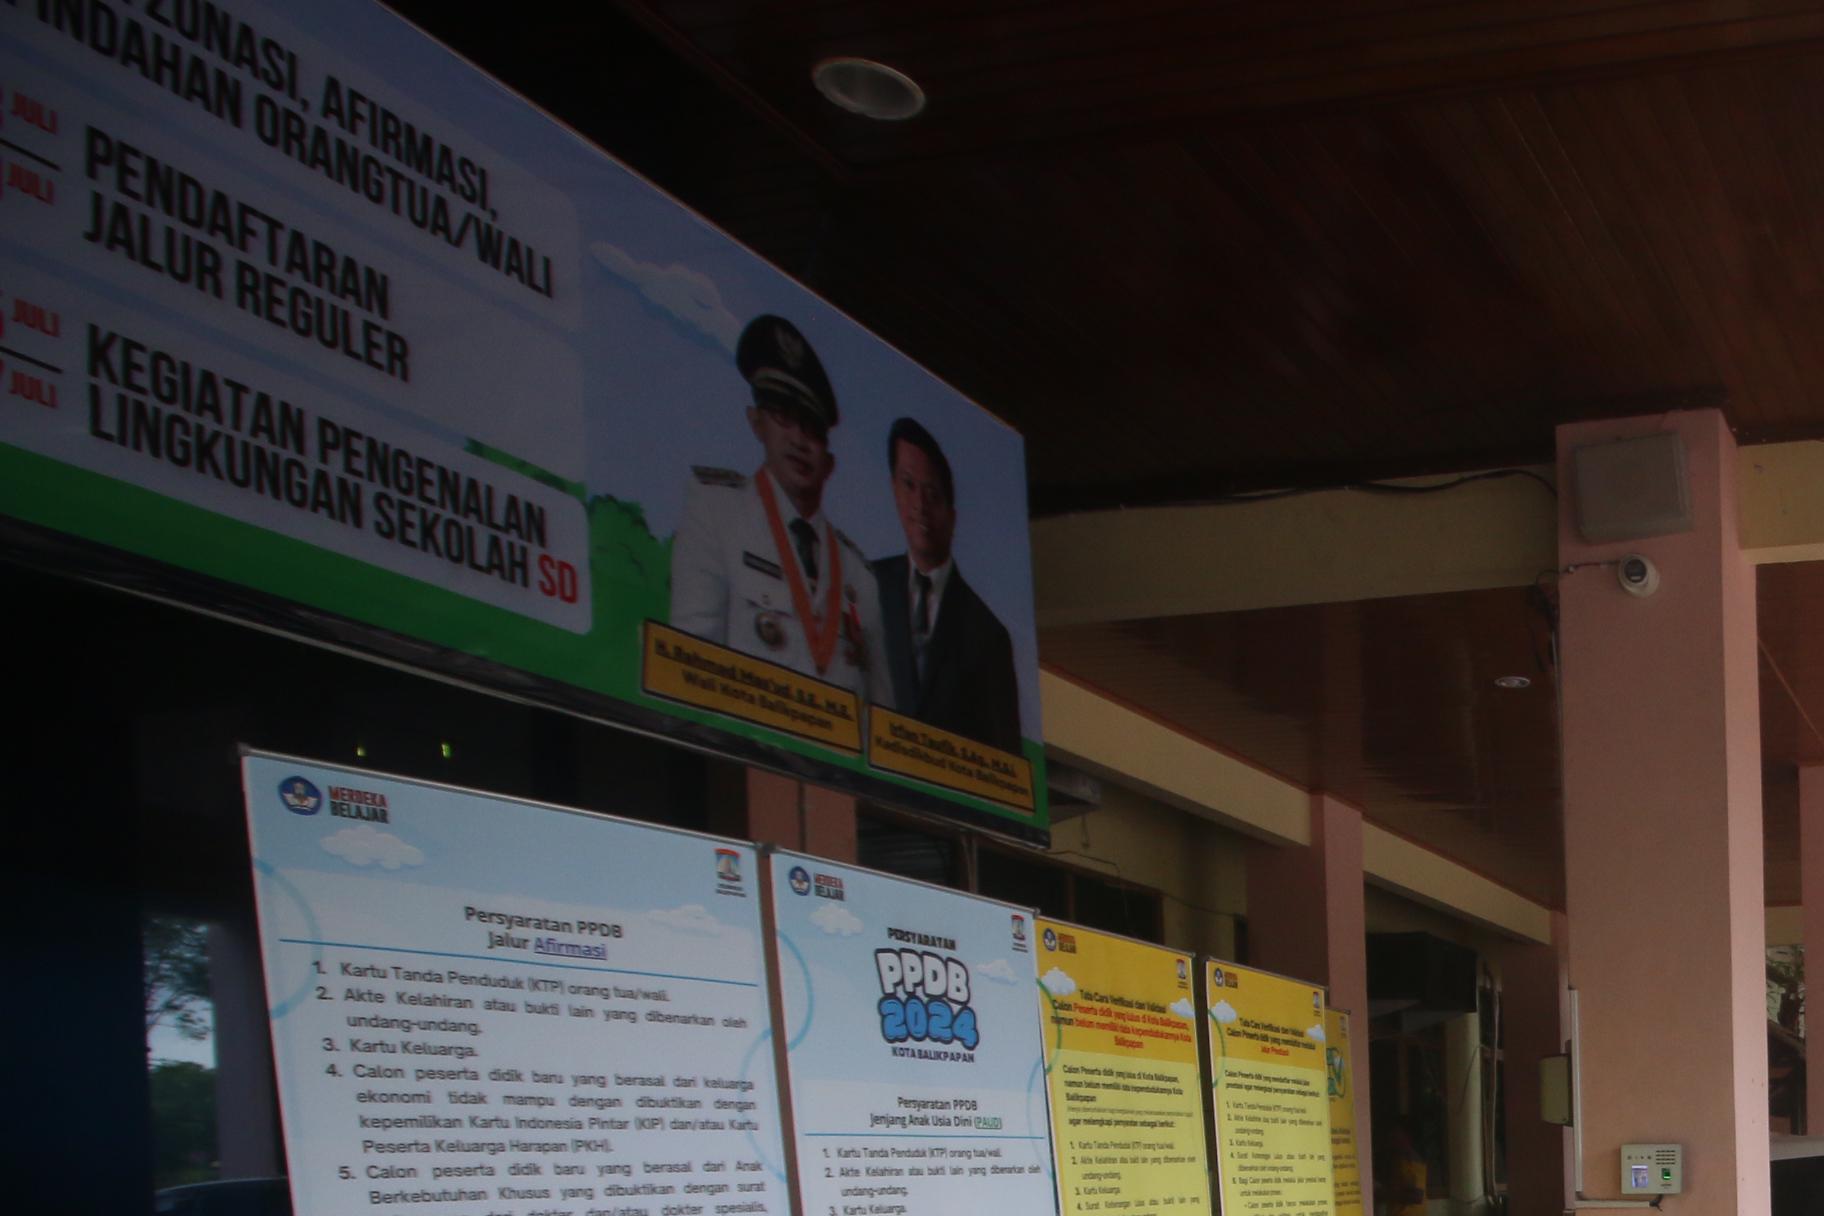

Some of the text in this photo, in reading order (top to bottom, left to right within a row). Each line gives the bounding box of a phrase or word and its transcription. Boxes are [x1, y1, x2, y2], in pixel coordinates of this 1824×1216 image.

[11, 91, 58, 135] JULI
[322, 74, 498, 217] AFIRMASI,
[7, 162, 54, 205] JULI
[255, 93, 555, 298] ORANGTUA/WALI
[86, 125, 389, 320] PENDAFTARAN
[83, 190, 410, 383] JALUR REGULER
[12, 298, 60, 337] JULI
[9, 370, 58, 408] JULI
[87, 323, 547, 549] KEGIATAN PENGENALAN
[89, 383, 578, 605] LINGKUNGAN SEKOLAH SD
[327, 786, 387, 809] MERDEKA
[328, 801, 389, 823] BELAJAR
[463, 905, 623, 938] Persyaratan PPDB
[885, 927, 956, 950] PERSYARATAN
[486, 931, 608, 960] Jalur Afirmasi
[310, 959, 327, 974] 1.
[339, 962, 388, 979] Kartu
[389, 965, 444, 983] Tanda
[445, 970, 524, 989] Penduduk
[526, 977, 564, 993] (KTP)
[566, 984, 611, 1000] orang
[875, 948, 971, 1007] PPDB
[877, 994, 980, 1051] 2024
[321, 1036, 479, 1059] 3. Kartu Keluarga.
[890, 1046, 975, 1063] KOTA BALIKPAPAN
[351, 1063, 405, 1078] Calon
[413, 1067, 480, 1081] peserta
[487, 1068, 524, 1082] didik
[530, 1070, 565, 1084] baru
[570, 1074, 607, 1088] yang
[613, 1073, 666, 1087] berasal
[671, 1075, 697, 1088] dari
[702, 1077, 755, 1092] keluarga
[358, 1114, 463, 1129] kepemilikan
[467, 1115, 511, 1129] Kartu
[513, 1116, 584, 1130] Indonesia
[587, 1116, 630, 1130] Pintar
[727, 1118, 759, 1131] Kartu
[869, 1113, 1003, 1130] Jenjang Anak Usia Dini (PAUD)
[896, 1096, 978, 1112] Persyaratan PPDB
[361, 1139, 431, 1153] Peserta
[433, 1139, 507, 1155] Keluarga
[508, 1139, 568, 1153] Harapan
